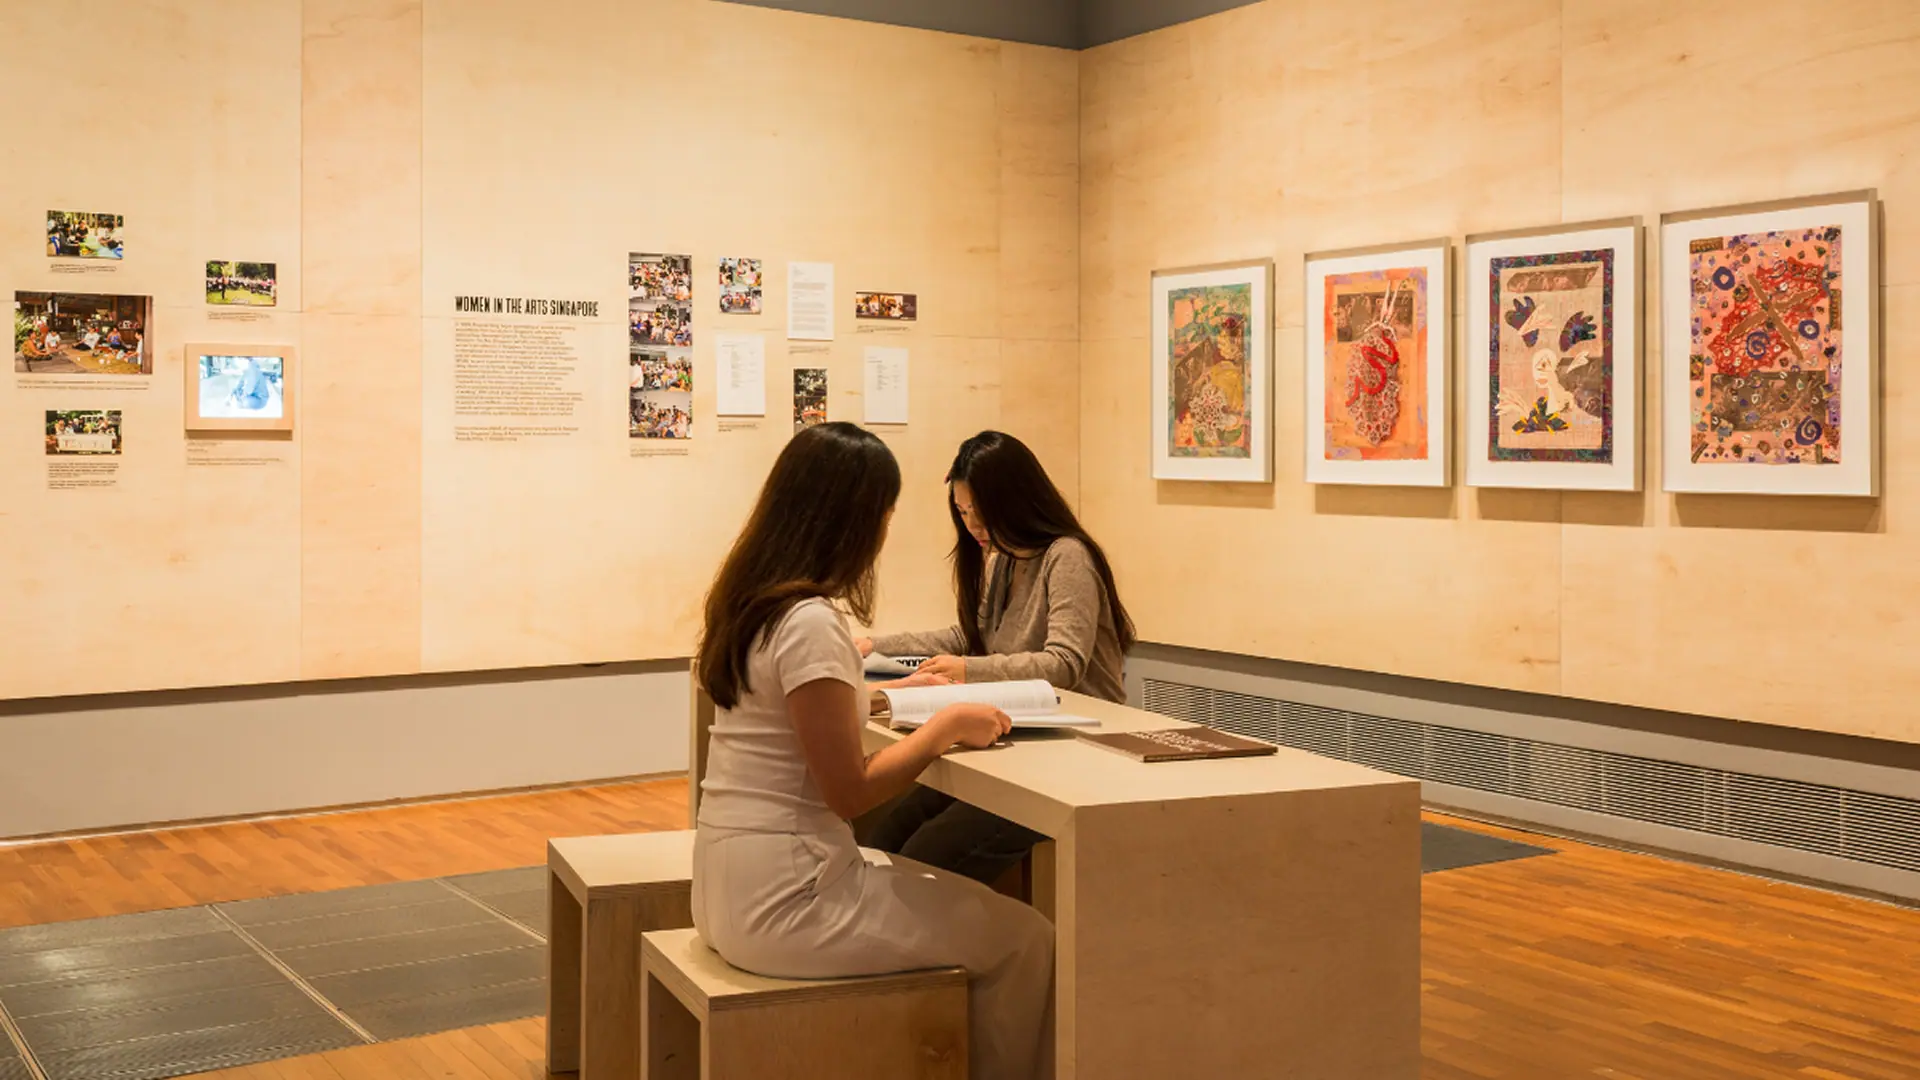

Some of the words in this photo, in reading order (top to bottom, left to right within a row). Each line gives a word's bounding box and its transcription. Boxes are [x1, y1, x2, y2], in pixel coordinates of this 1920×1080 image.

[455, 296, 490, 312] WOMEN
[494, 297, 503, 313] IN
[506, 298, 522, 314] THE
[525, 299, 547, 315] ARTS
[550, 299, 599, 316] SINGAPORE
